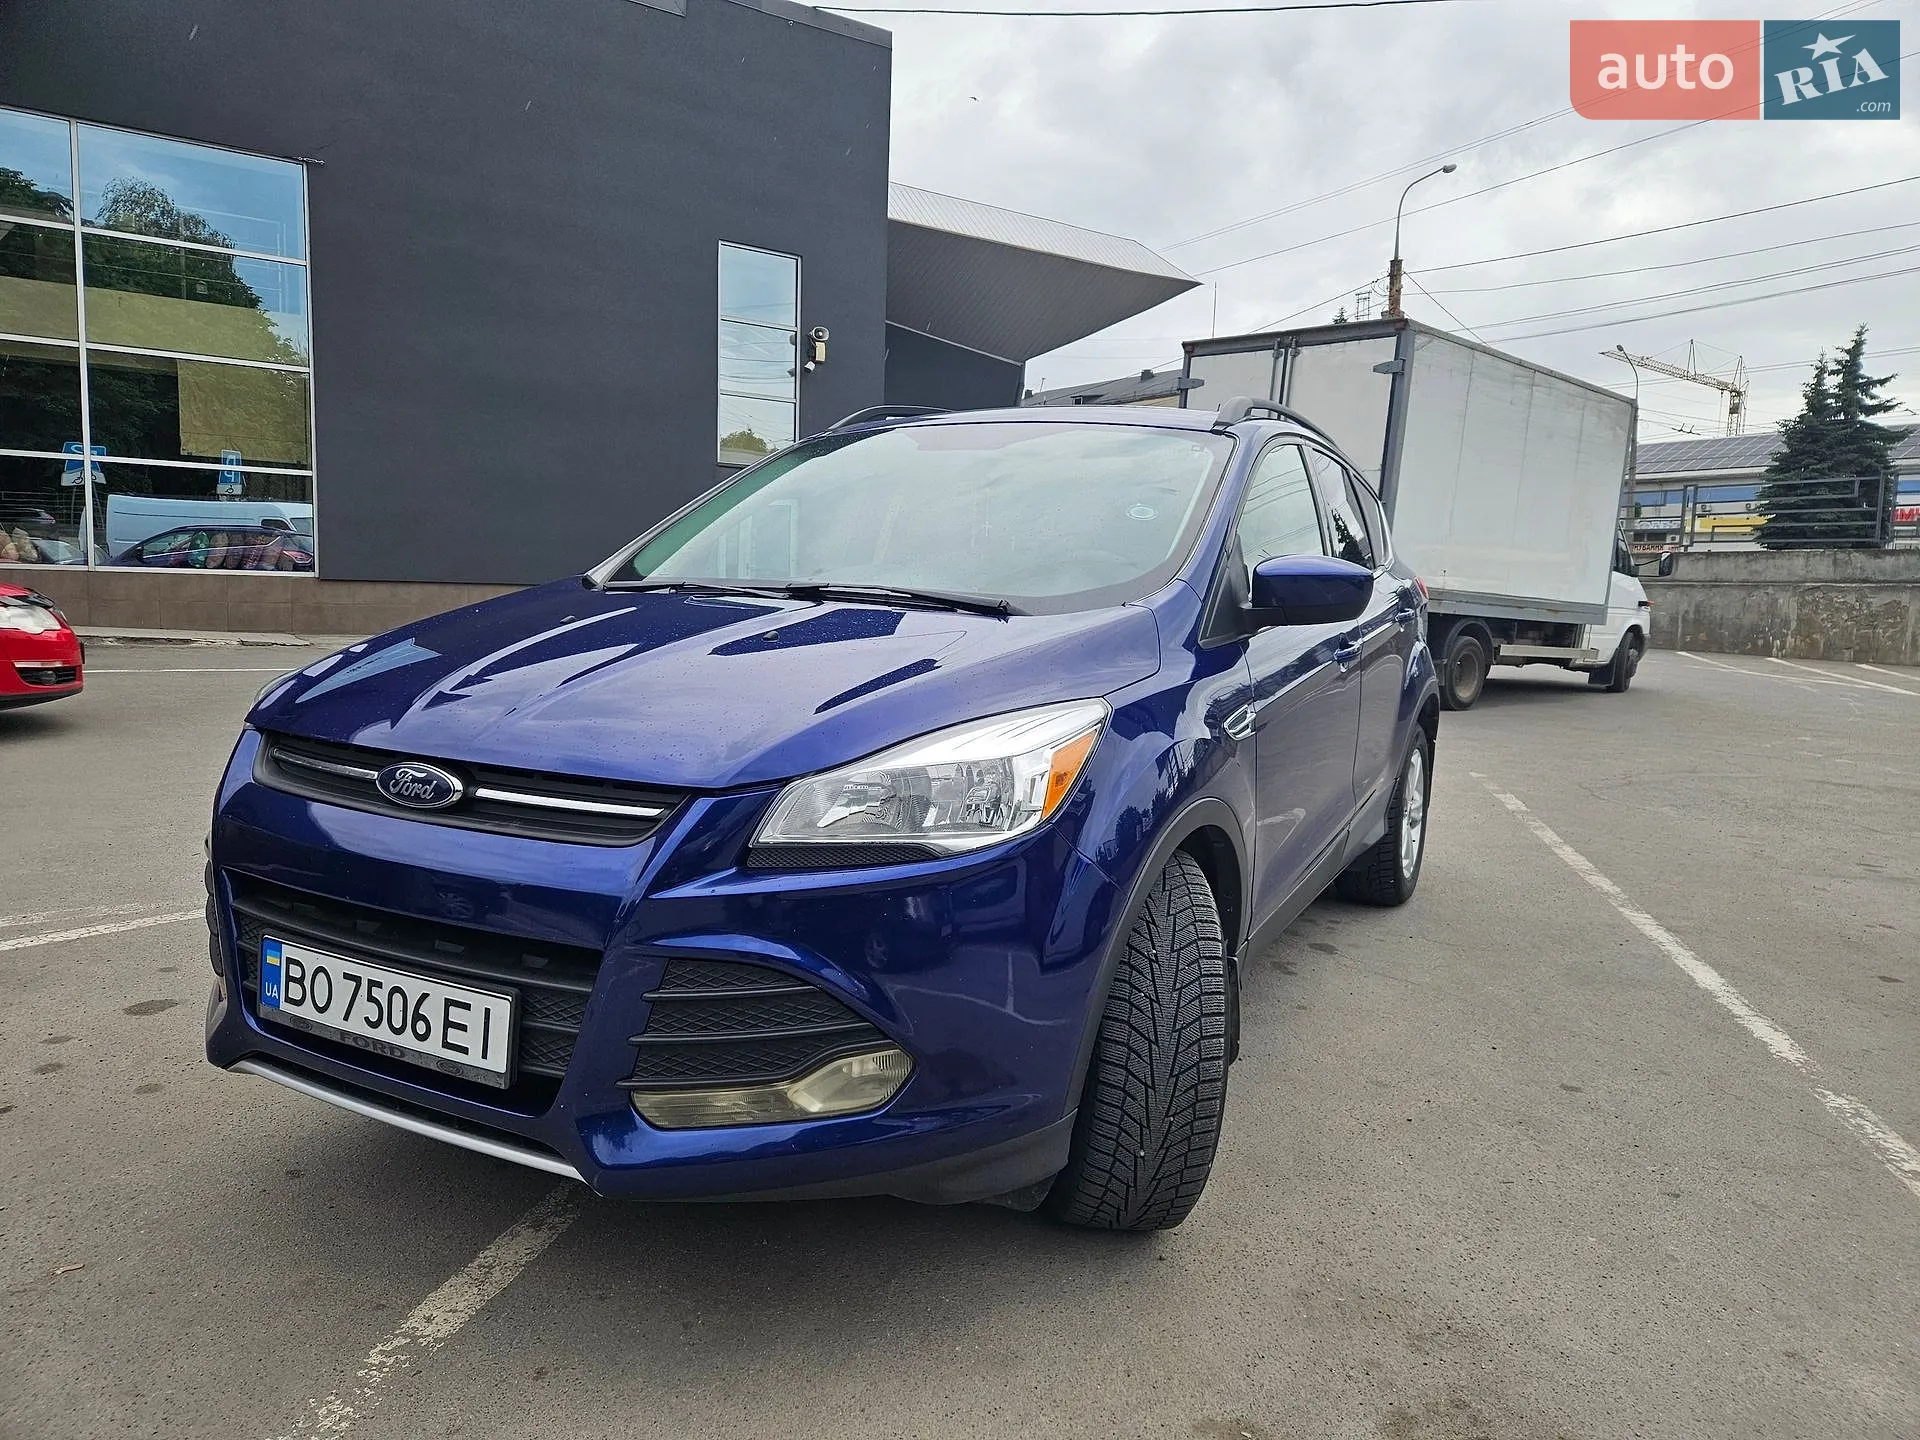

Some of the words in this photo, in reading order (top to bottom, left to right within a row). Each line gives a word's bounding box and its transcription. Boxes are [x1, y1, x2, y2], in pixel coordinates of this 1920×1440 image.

[389, 768, 438, 800] Ford
[265, 981, 279, 1000] UA
[342, 971, 432, 1043] 7506
[339, 1031, 406, 1059] FORD
